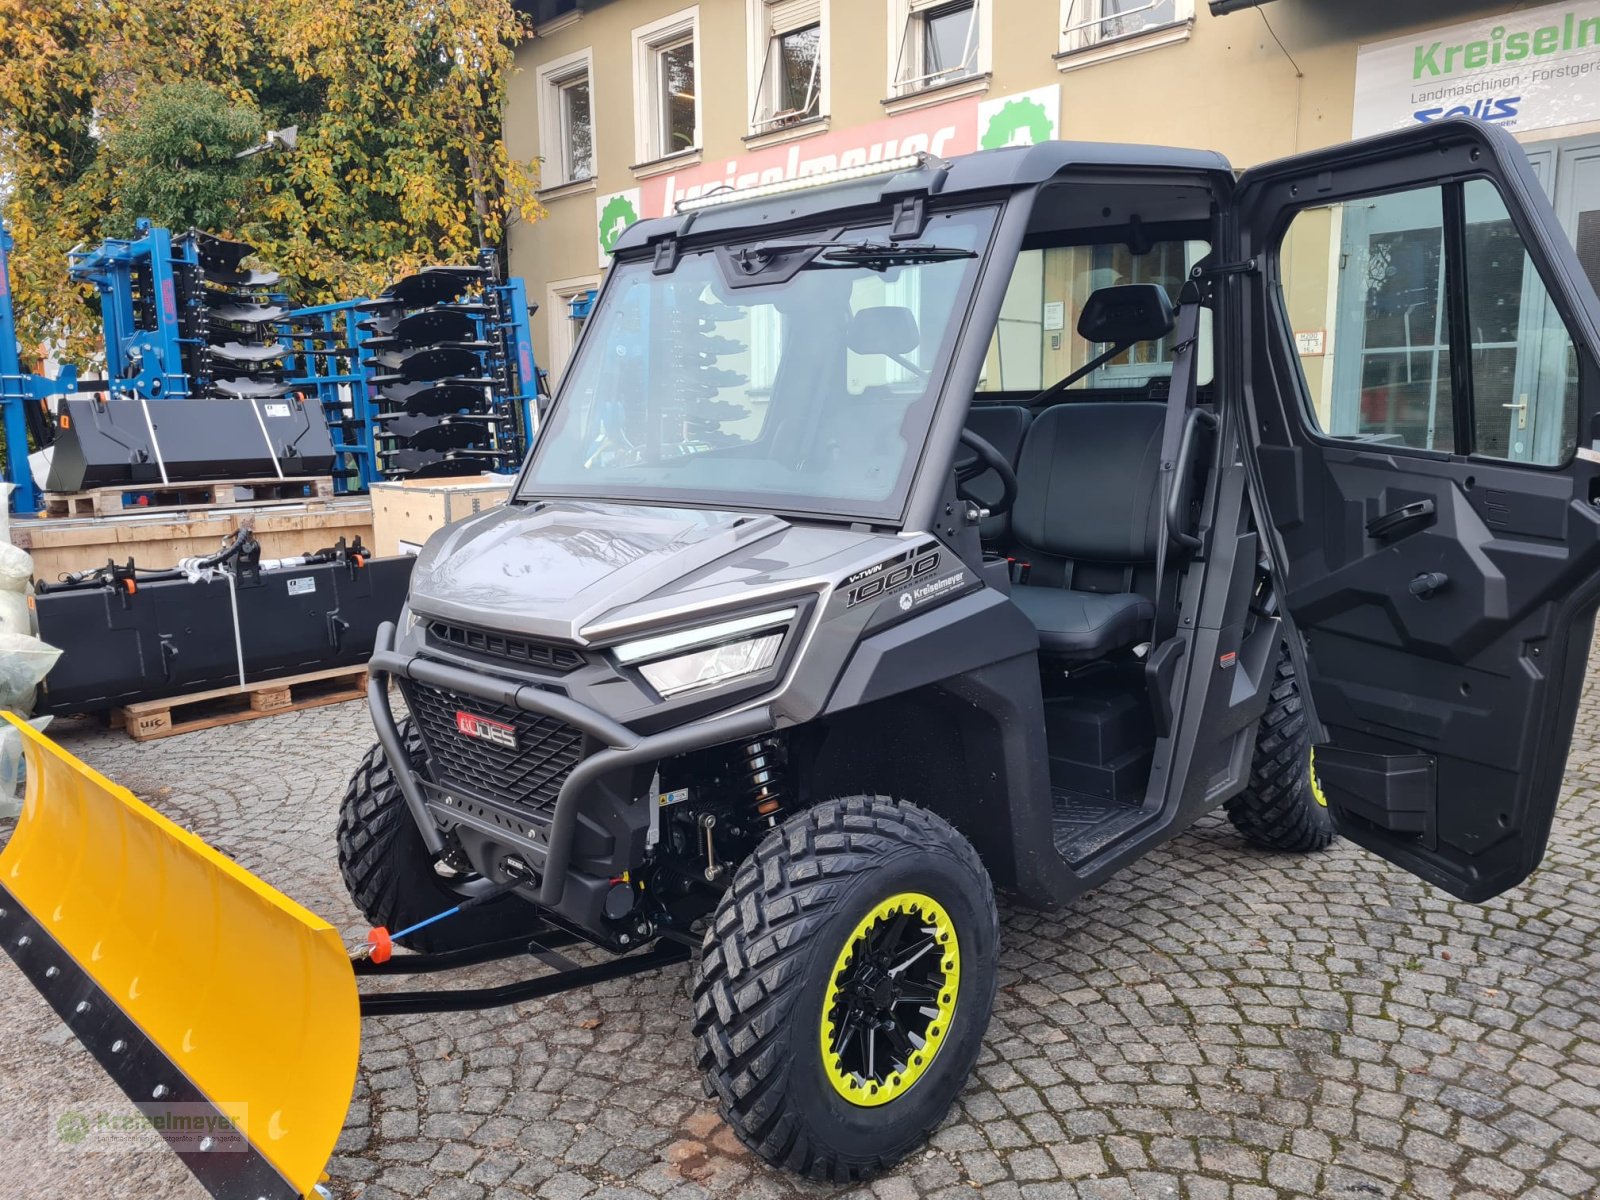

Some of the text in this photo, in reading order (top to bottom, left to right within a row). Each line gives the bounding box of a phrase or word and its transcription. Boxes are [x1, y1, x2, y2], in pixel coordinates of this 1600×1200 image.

[1410, 76, 1520, 104] Landmaschinen
[846, 552, 941, 608] 1000
[849, 563, 883, 583] V-TWIN
